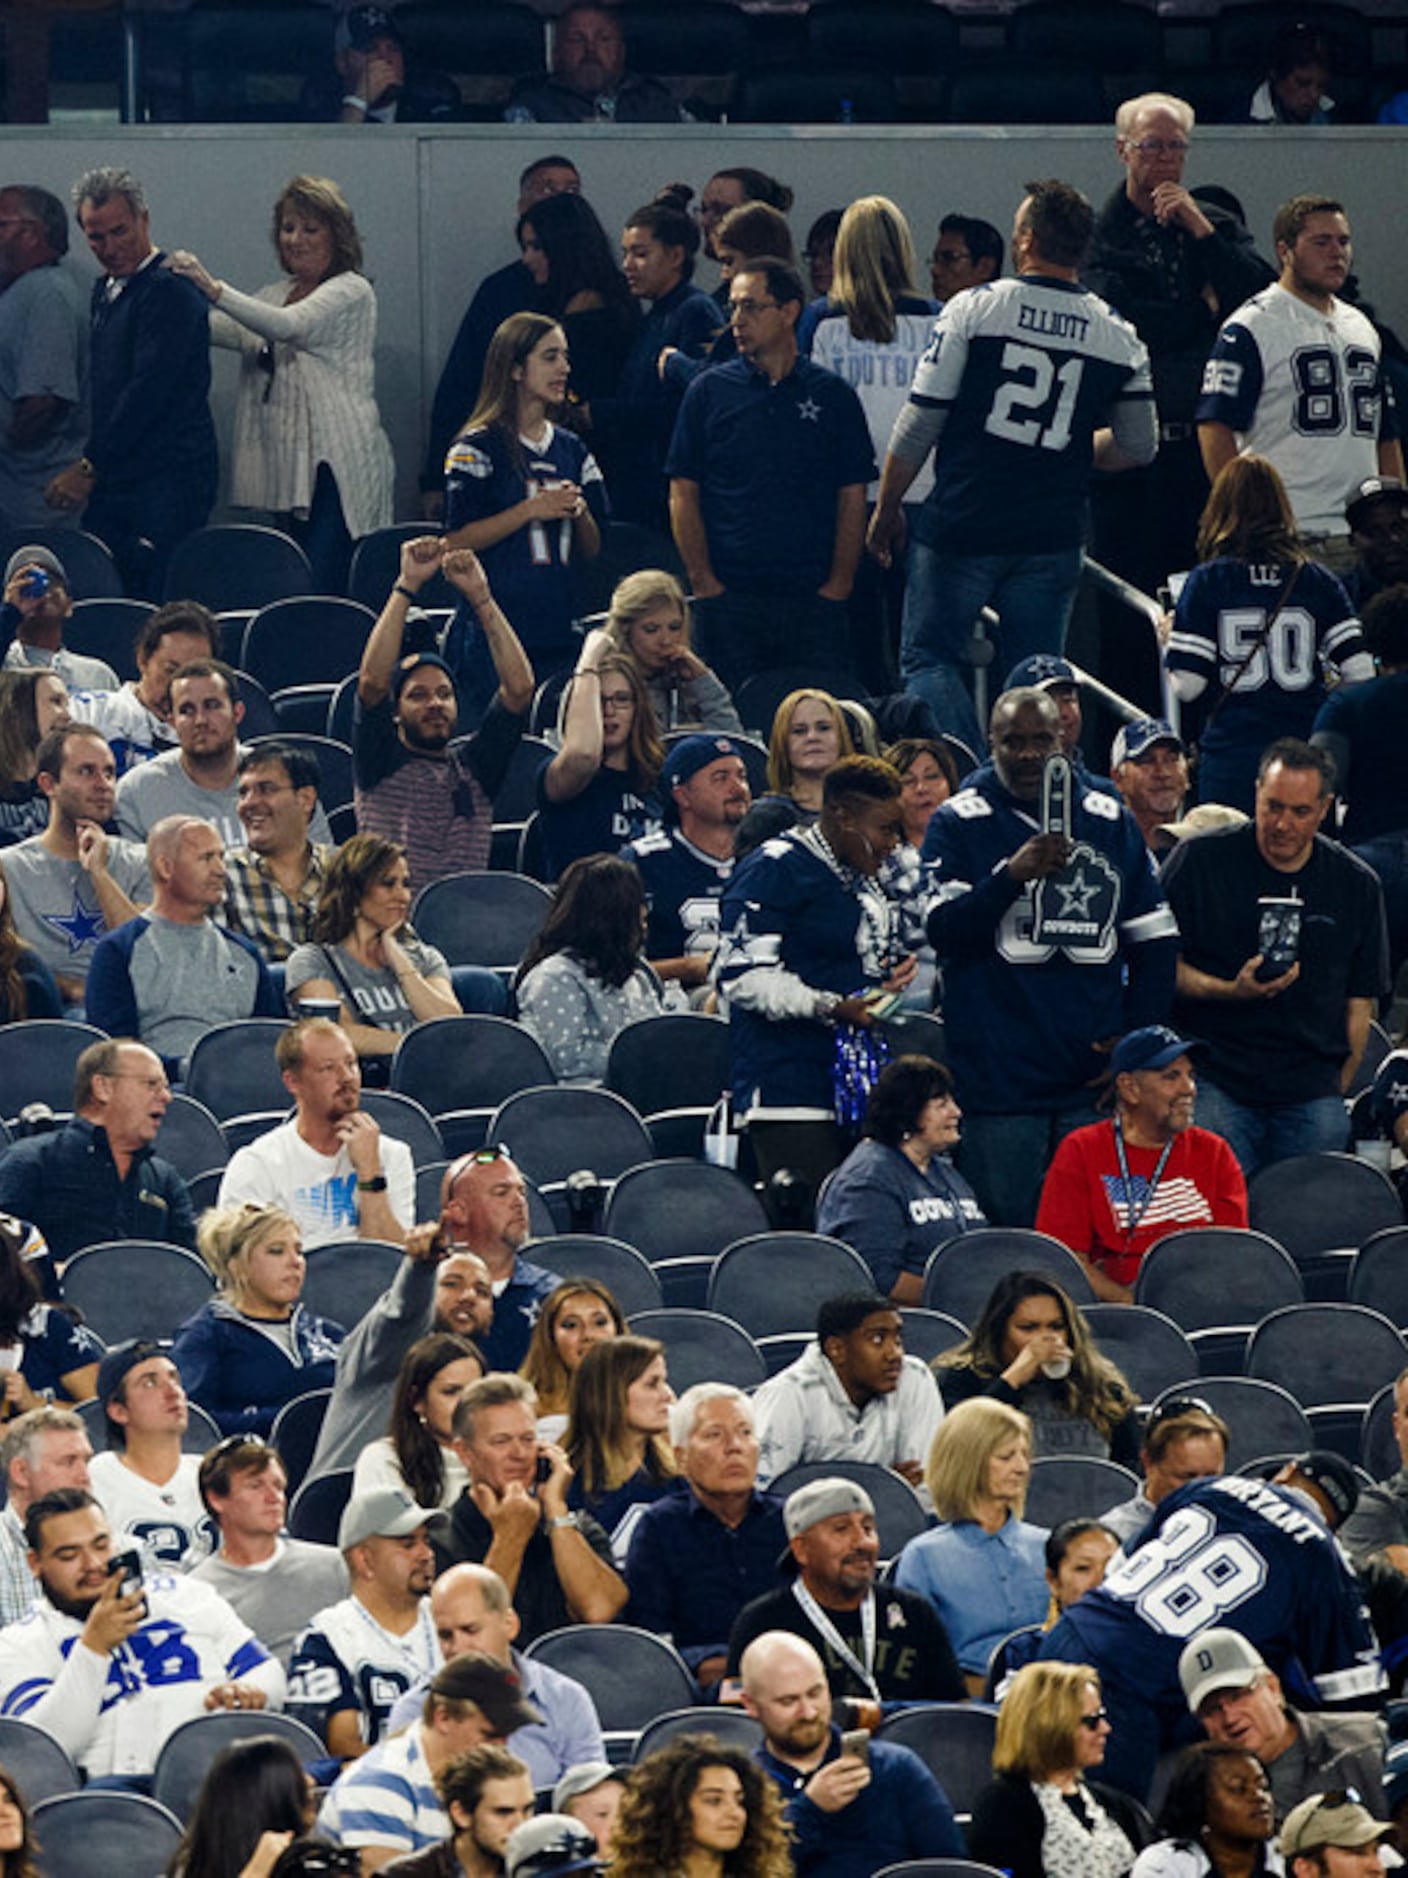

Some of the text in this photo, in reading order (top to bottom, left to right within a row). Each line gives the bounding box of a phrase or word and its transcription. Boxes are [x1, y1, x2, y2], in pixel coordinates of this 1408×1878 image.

[1017, 303, 1089, 343] ELLIOTT
[985, 342, 1084, 452] 21
[1218, 606, 1316, 692] 50
[1100, 1504, 1271, 1643] 88
[1196, 1649, 1214, 1673] D
